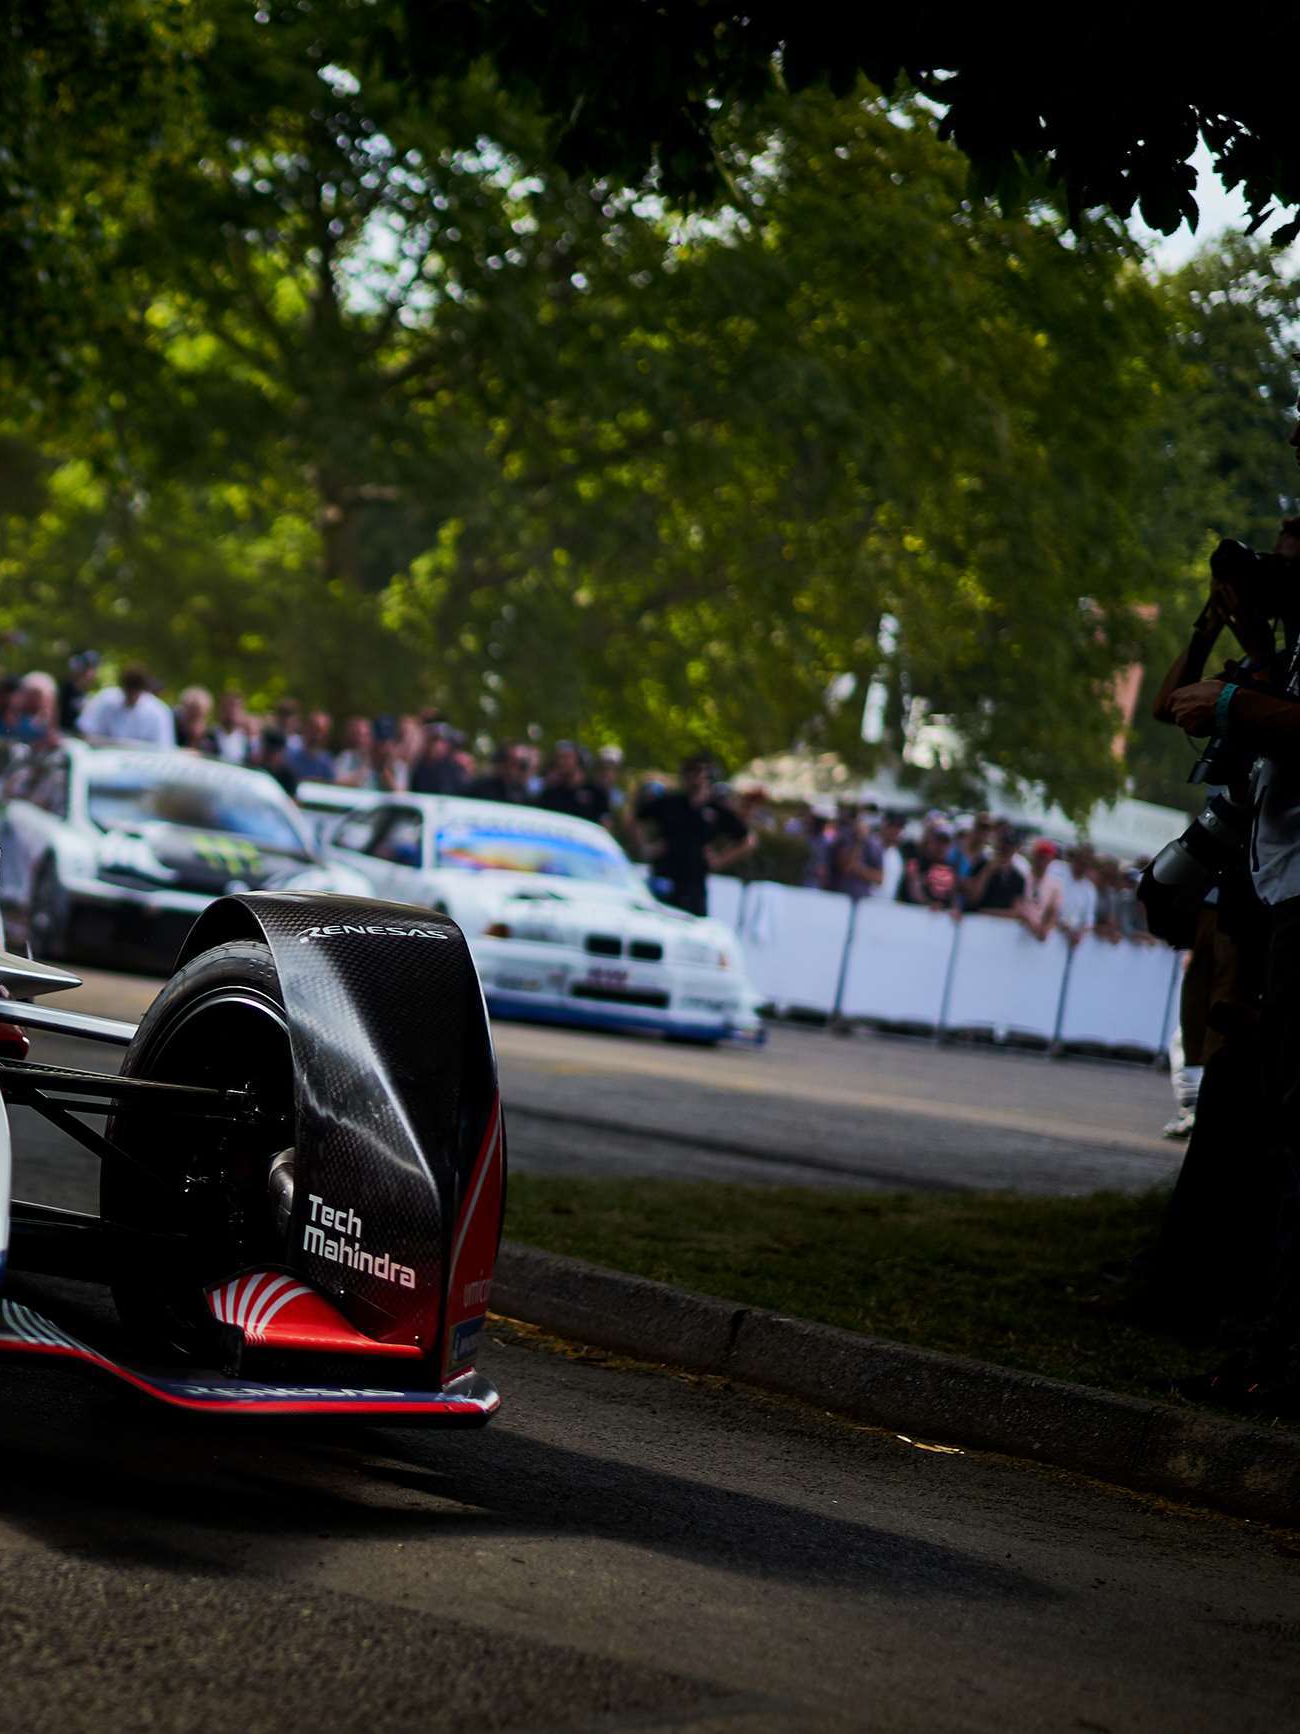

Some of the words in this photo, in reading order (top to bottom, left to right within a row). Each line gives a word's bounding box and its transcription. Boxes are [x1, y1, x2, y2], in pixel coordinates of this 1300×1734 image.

[296, 925, 449, 944] RENESAS
[308, 1193, 362, 1239] Tech
[302, 1224, 416, 1289] Mahindra
